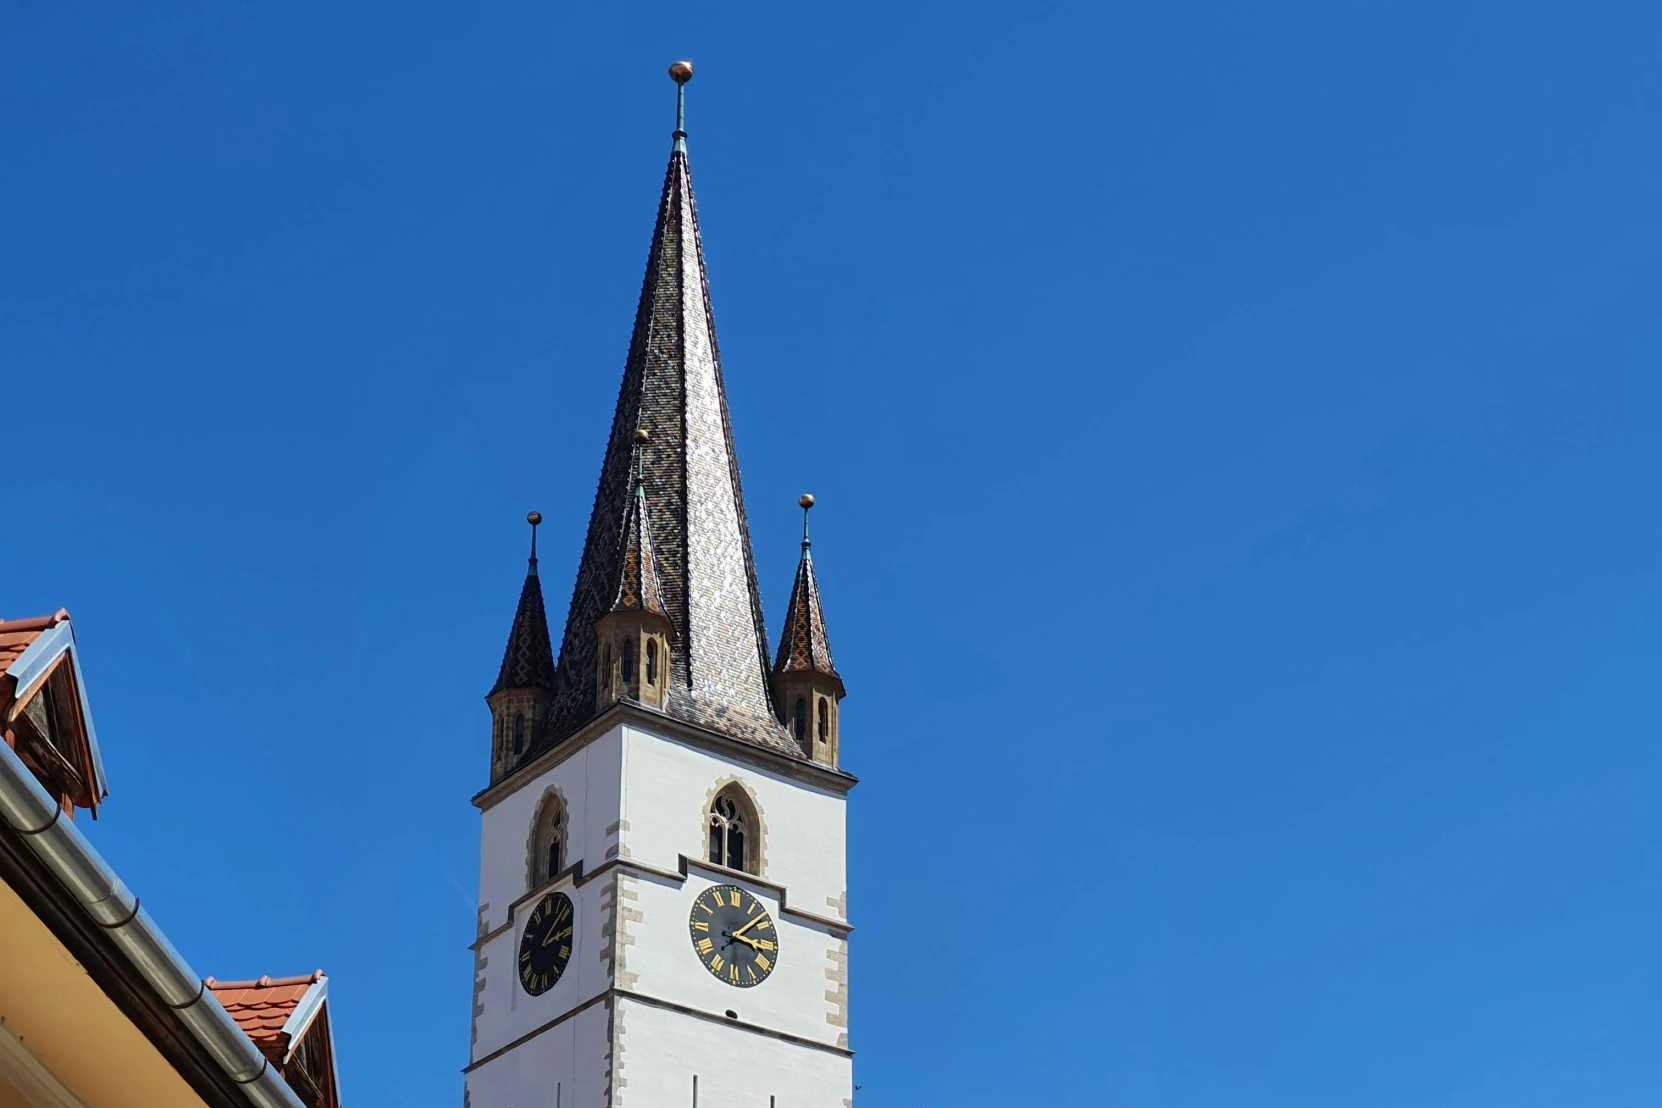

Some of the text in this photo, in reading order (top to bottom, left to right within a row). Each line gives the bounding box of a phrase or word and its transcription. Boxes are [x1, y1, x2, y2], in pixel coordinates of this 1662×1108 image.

[712, 890, 725, 908] XI
[730, 890, 741, 908] XII
[699, 901, 714, 916] X
[747, 902, 756, 915] I
[694, 919, 709, 933] IX
[756, 920, 770, 930] II
[710, 953, 725, 972] VII
[730, 963, 739, 980] VI
[747, 964, 757, 980] V
